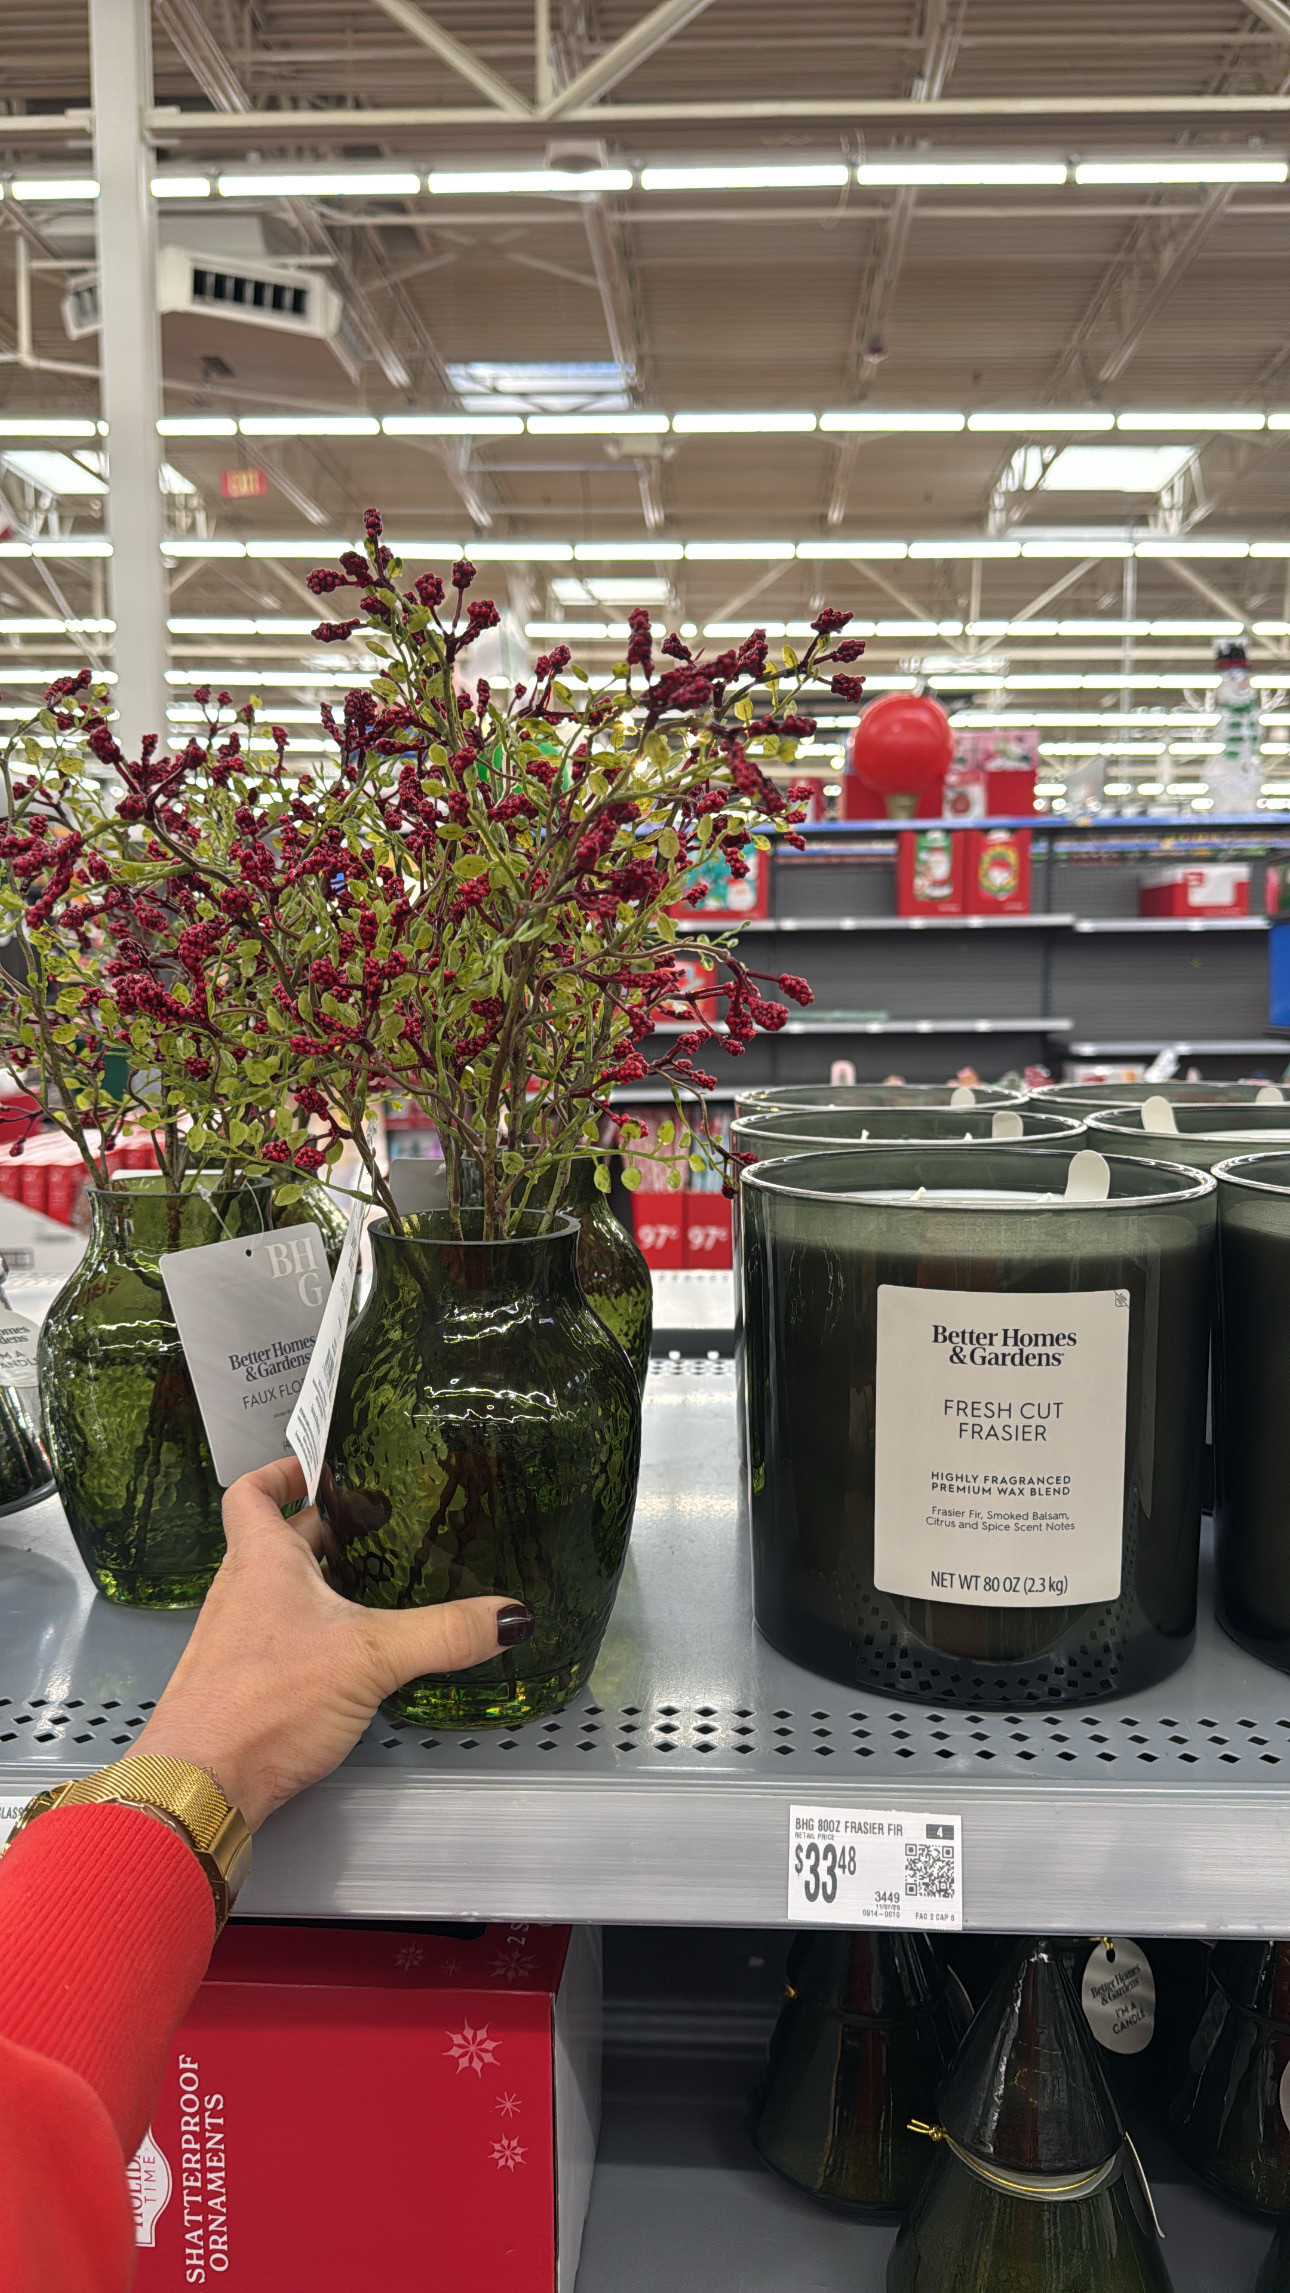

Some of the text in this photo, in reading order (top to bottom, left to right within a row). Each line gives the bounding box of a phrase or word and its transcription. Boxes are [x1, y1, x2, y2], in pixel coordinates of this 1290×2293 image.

[932, 1324, 1078, 1348] Better Homes
[229, 1335, 317, 1371] Better Homes
[242, 1386, 277, 1410] FAUX
[944, 1399, 1064, 1419] FRESH CUT
[959, 1422, 1047, 1441] FRASIER
[931, 1471, 1071, 1486] HIGHLY FRAGRANCED
[931, 1482, 1071, 1497] PREMIUM WAX BLEND
[931, 1505, 1070, 1521] Frasier Fir, Smoked Balsam,
[925, 1515, 1076, 1533] Citrus and Spice Scent Notes
[931, 1570, 1068, 1597] NET WT 80 OZ (2.3 kg)
[794, 1831, 835, 1841] RETAIL PRICE
[795, 1817, 814, 1831] BHG
[844, 1821, 885, 1836] FRASIER
[887, 1823, 903, 1837] FIR
[936, 1826, 943, 1838] 4
[874, 1890, 900, 1904] 3449
[506, 1936, 527, 1945] 2
[1131, 2001, 1137, 2010] A
[1112, 2008, 1147, 2035] CANDLE
[178, 2053, 206, 2285] SHATTERPROOF
[143, 2156, 157, 2204] TIME
[204, 2093, 229, 2272] ORNAMENTS
